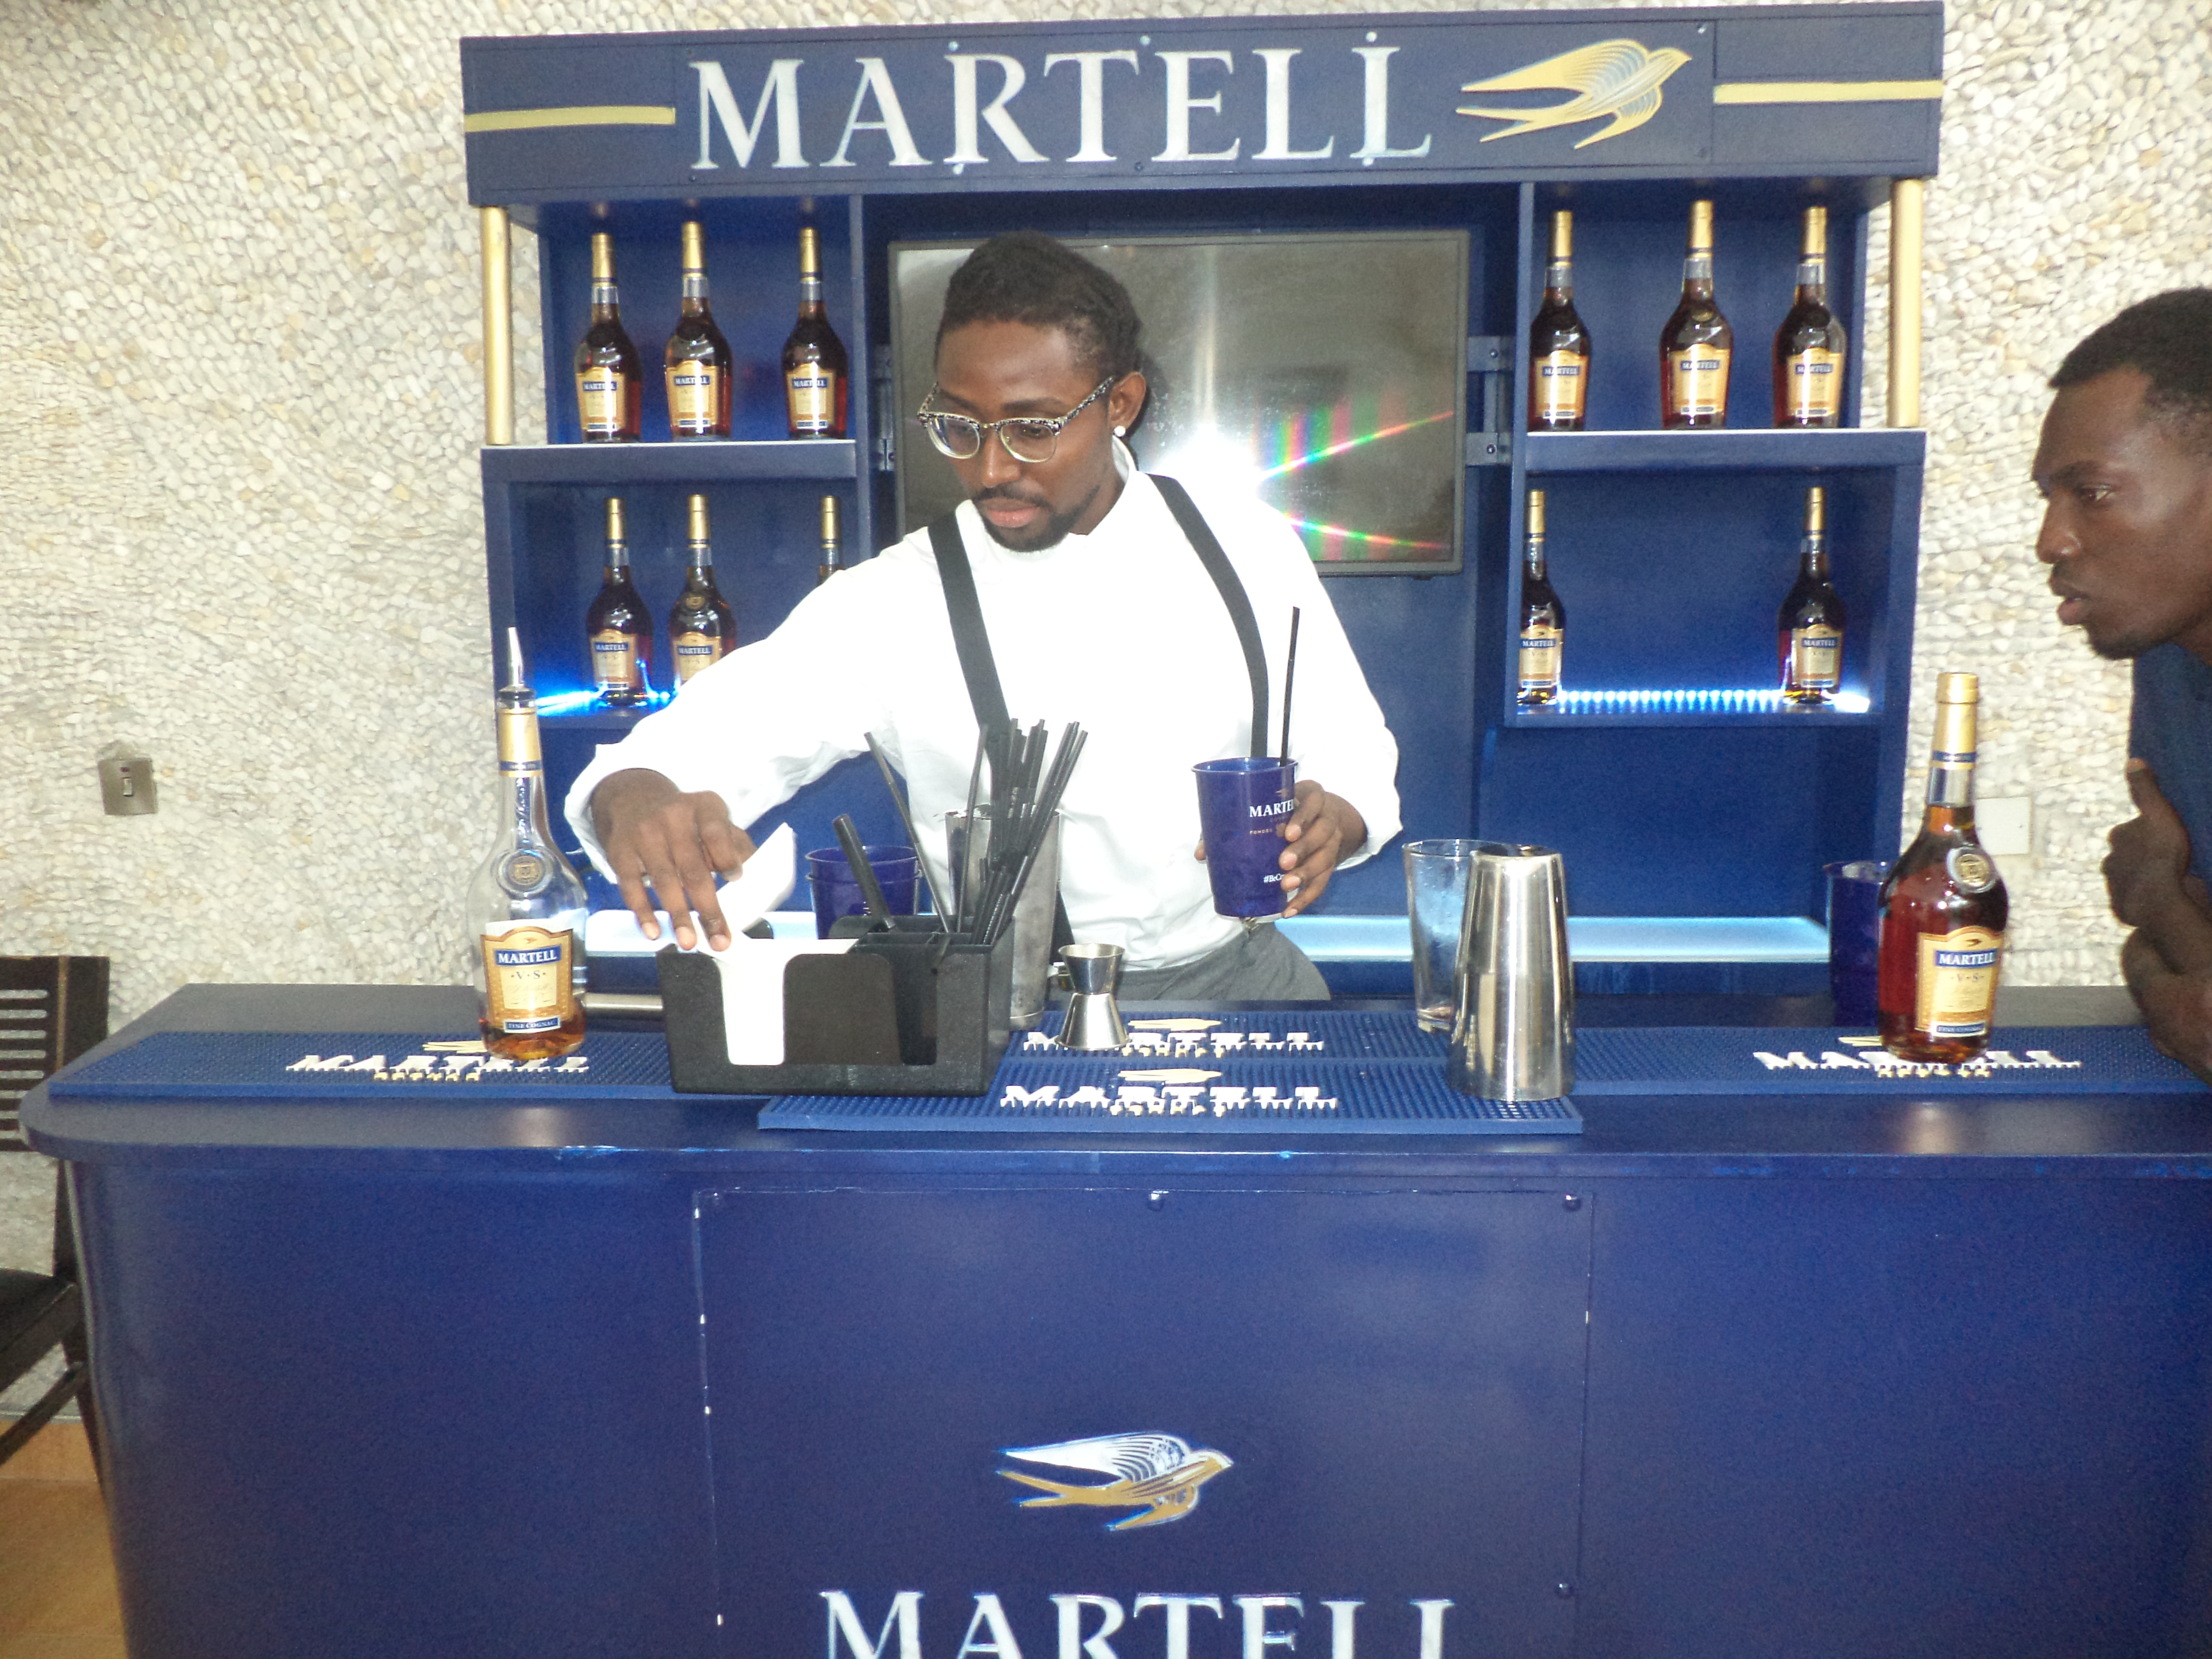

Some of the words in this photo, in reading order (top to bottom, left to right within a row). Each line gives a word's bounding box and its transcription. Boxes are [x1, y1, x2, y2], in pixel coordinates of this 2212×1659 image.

[689, 45, 1432, 171] MARTELL
[498, 950, 557, 963] MARTELL
[1939, 952, 1995, 965] MARTELL
[1024, 1032, 1324, 1051] MRTELL
[1000, 1086, 1337, 1110] MARTELL
